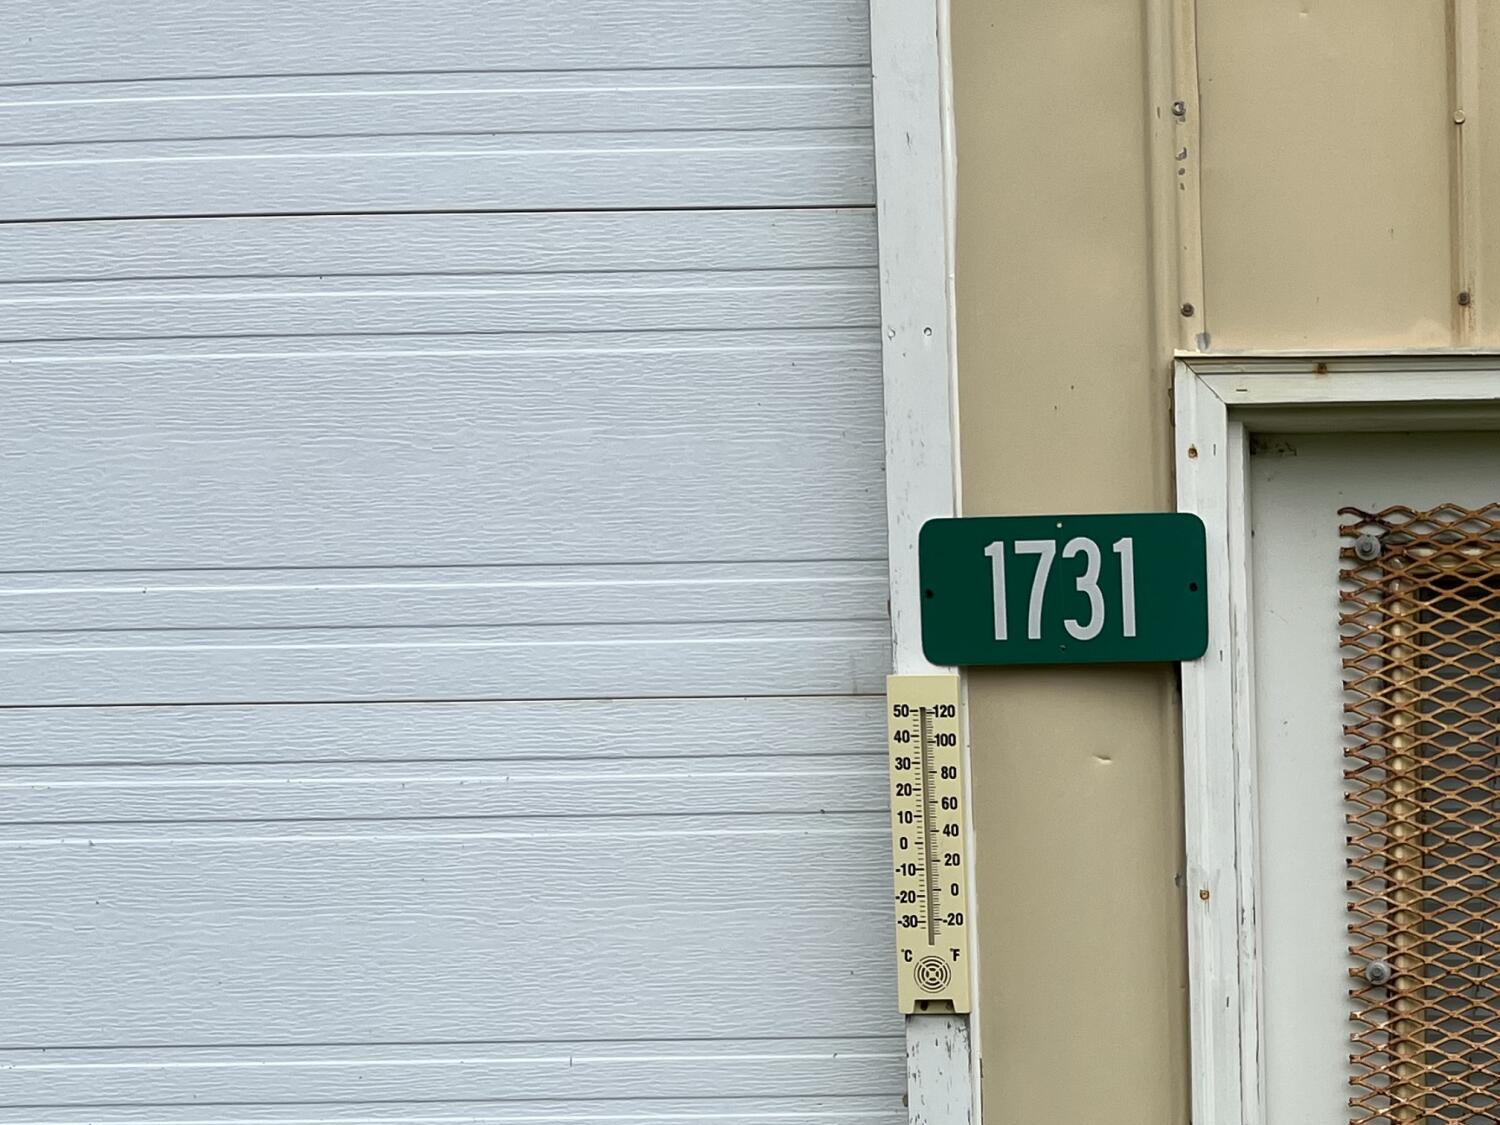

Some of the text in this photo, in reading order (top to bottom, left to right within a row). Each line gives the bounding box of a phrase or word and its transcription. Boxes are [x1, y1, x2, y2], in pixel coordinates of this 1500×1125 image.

[984, 537, 1137, 641] 1731
[893, 704, 909, 717] 50
[933, 705, 955, 717] 120
[894, 730, 910, 743] 40
[935, 734, 956, 746] 100
[895, 757, 910, 770] 30
[941, 766, 956, 779] 80
[896, 783, 912, 796] 20
[942, 797, 957, 809] 60
[897, 811, 912, 823] 10
[943, 824, 959, 836] 40
[900, 837, 908, 849] 0
[944, 854, 960, 866] 20
[951, 884, 959, 896] 0
